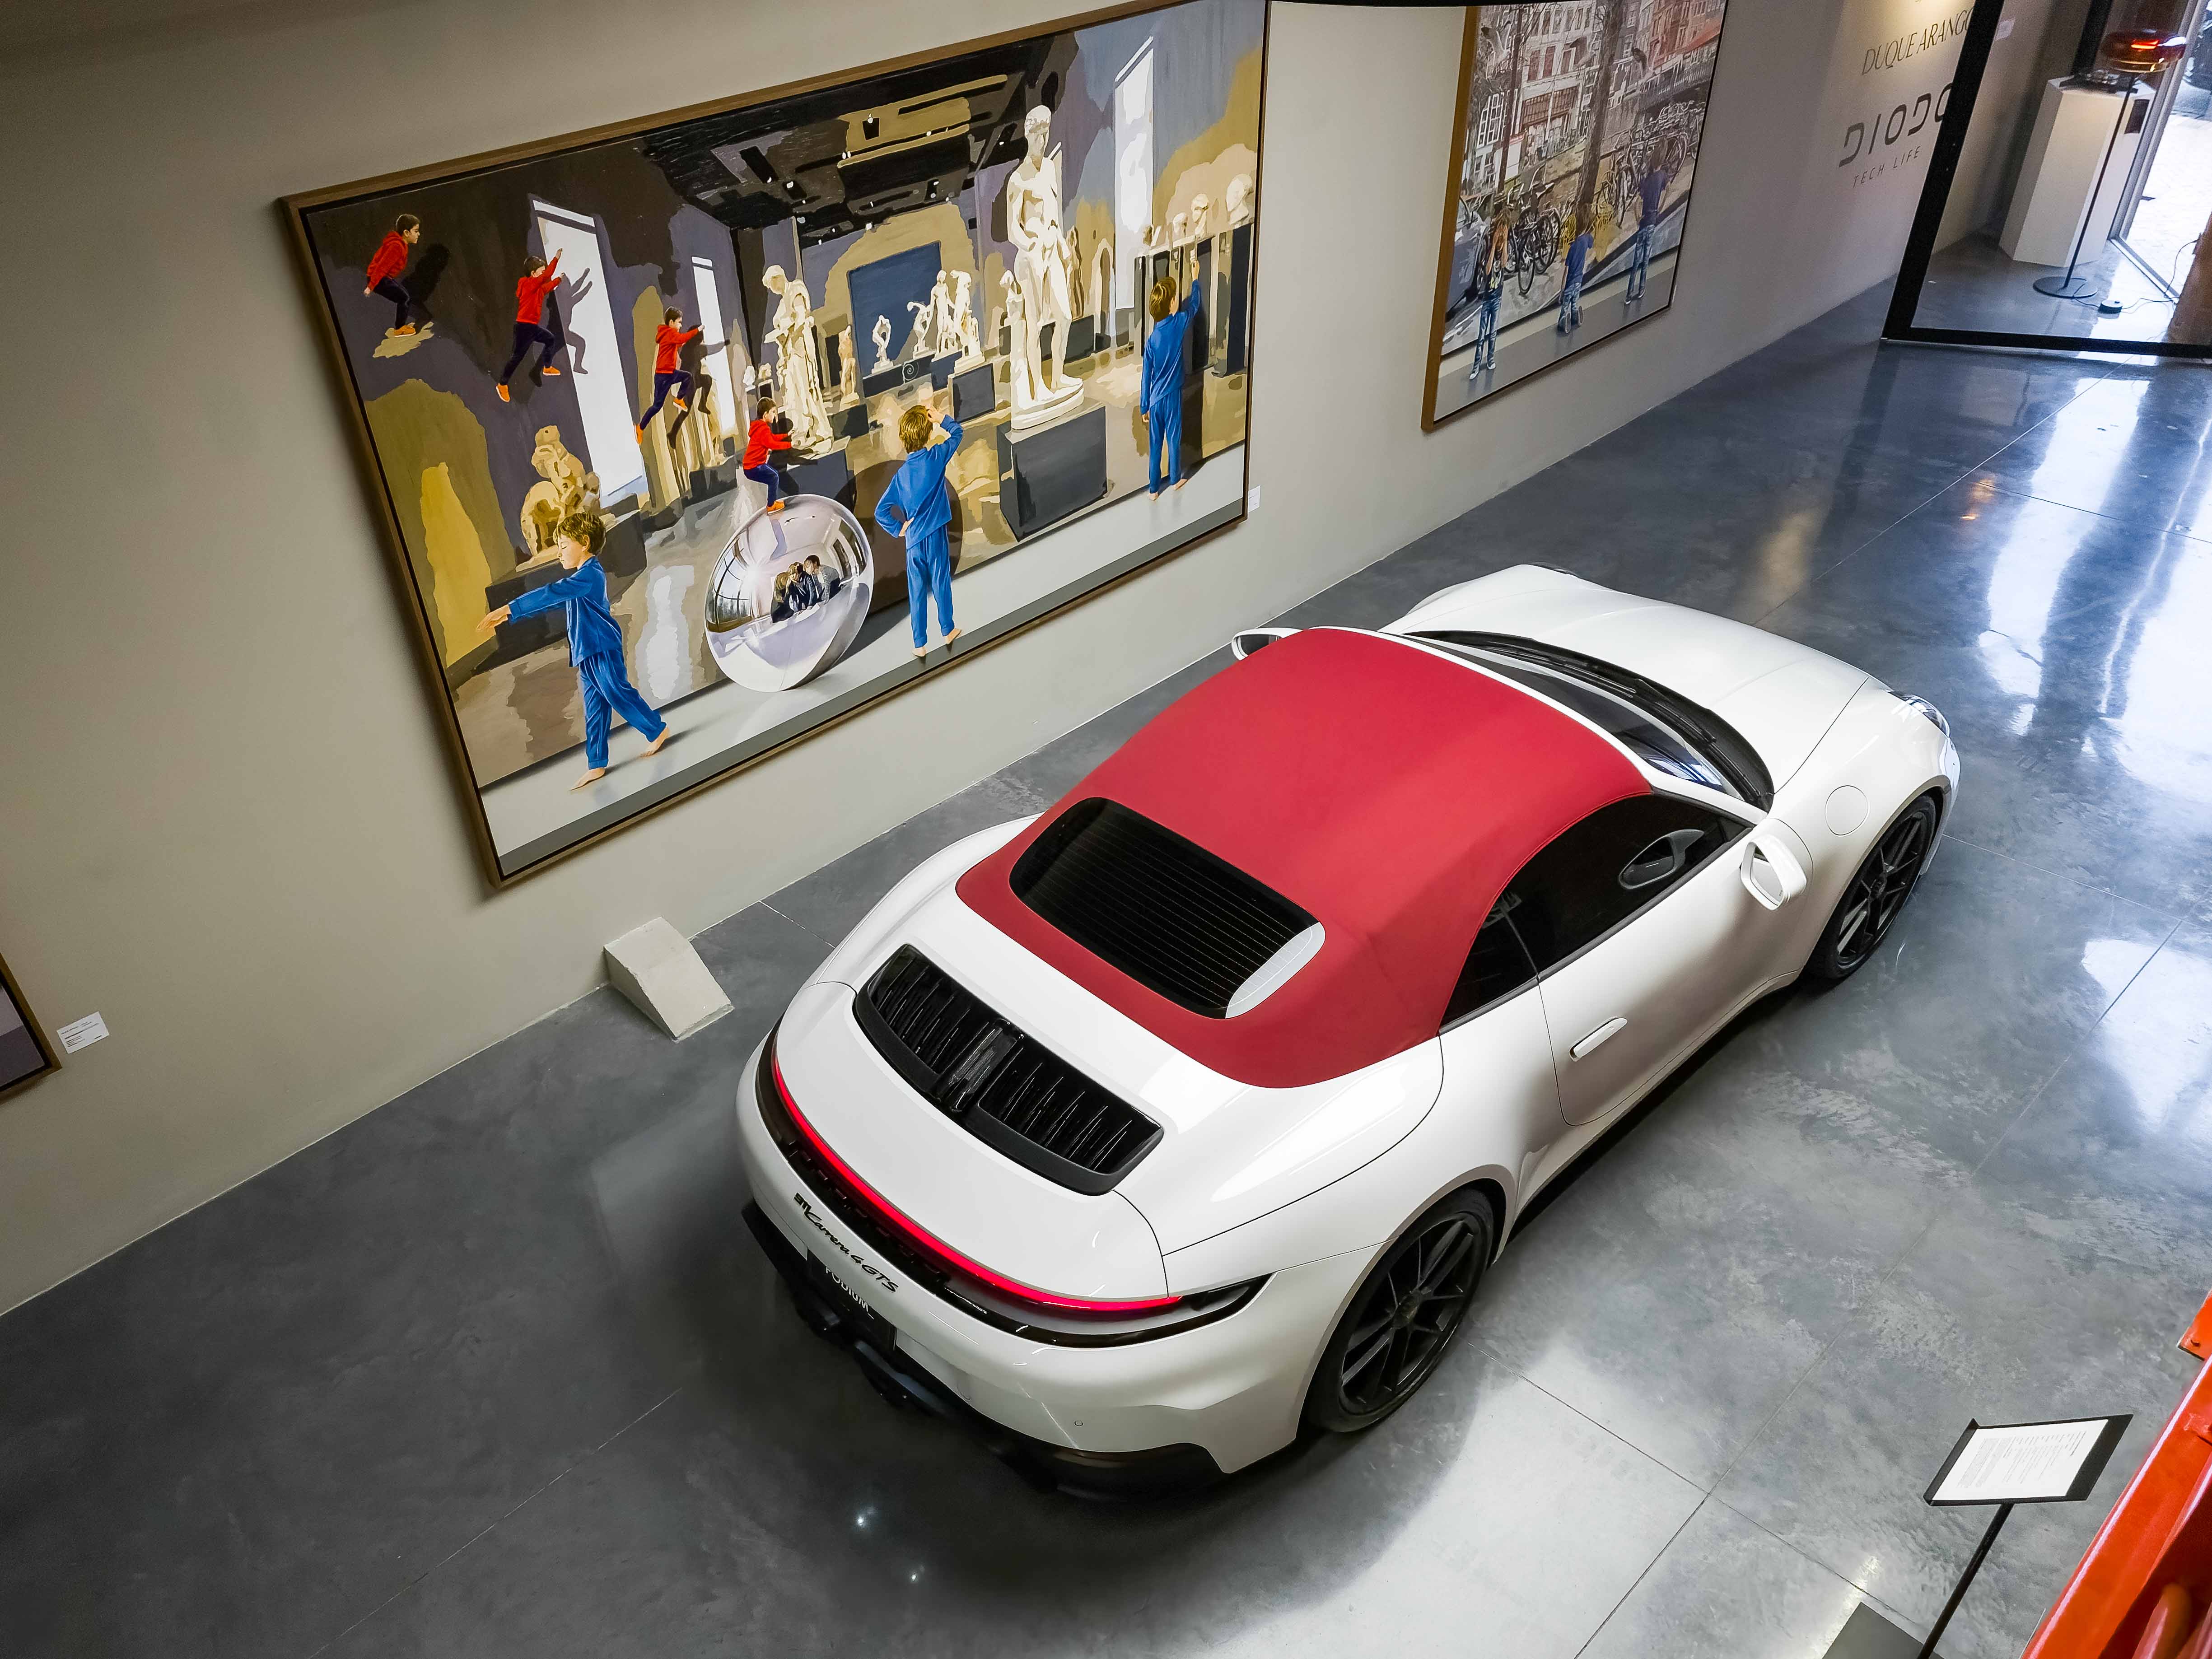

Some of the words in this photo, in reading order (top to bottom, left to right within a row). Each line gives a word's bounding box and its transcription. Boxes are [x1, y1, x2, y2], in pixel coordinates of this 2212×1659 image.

[1862, 33, 1918, 75] DUQUE
[1853, 163, 1885, 188] TECH
[1893, 145, 1921, 168] LIFE
[804, 1211, 850, 1255] Carrera
[861, 1264, 900, 1292] GTS
